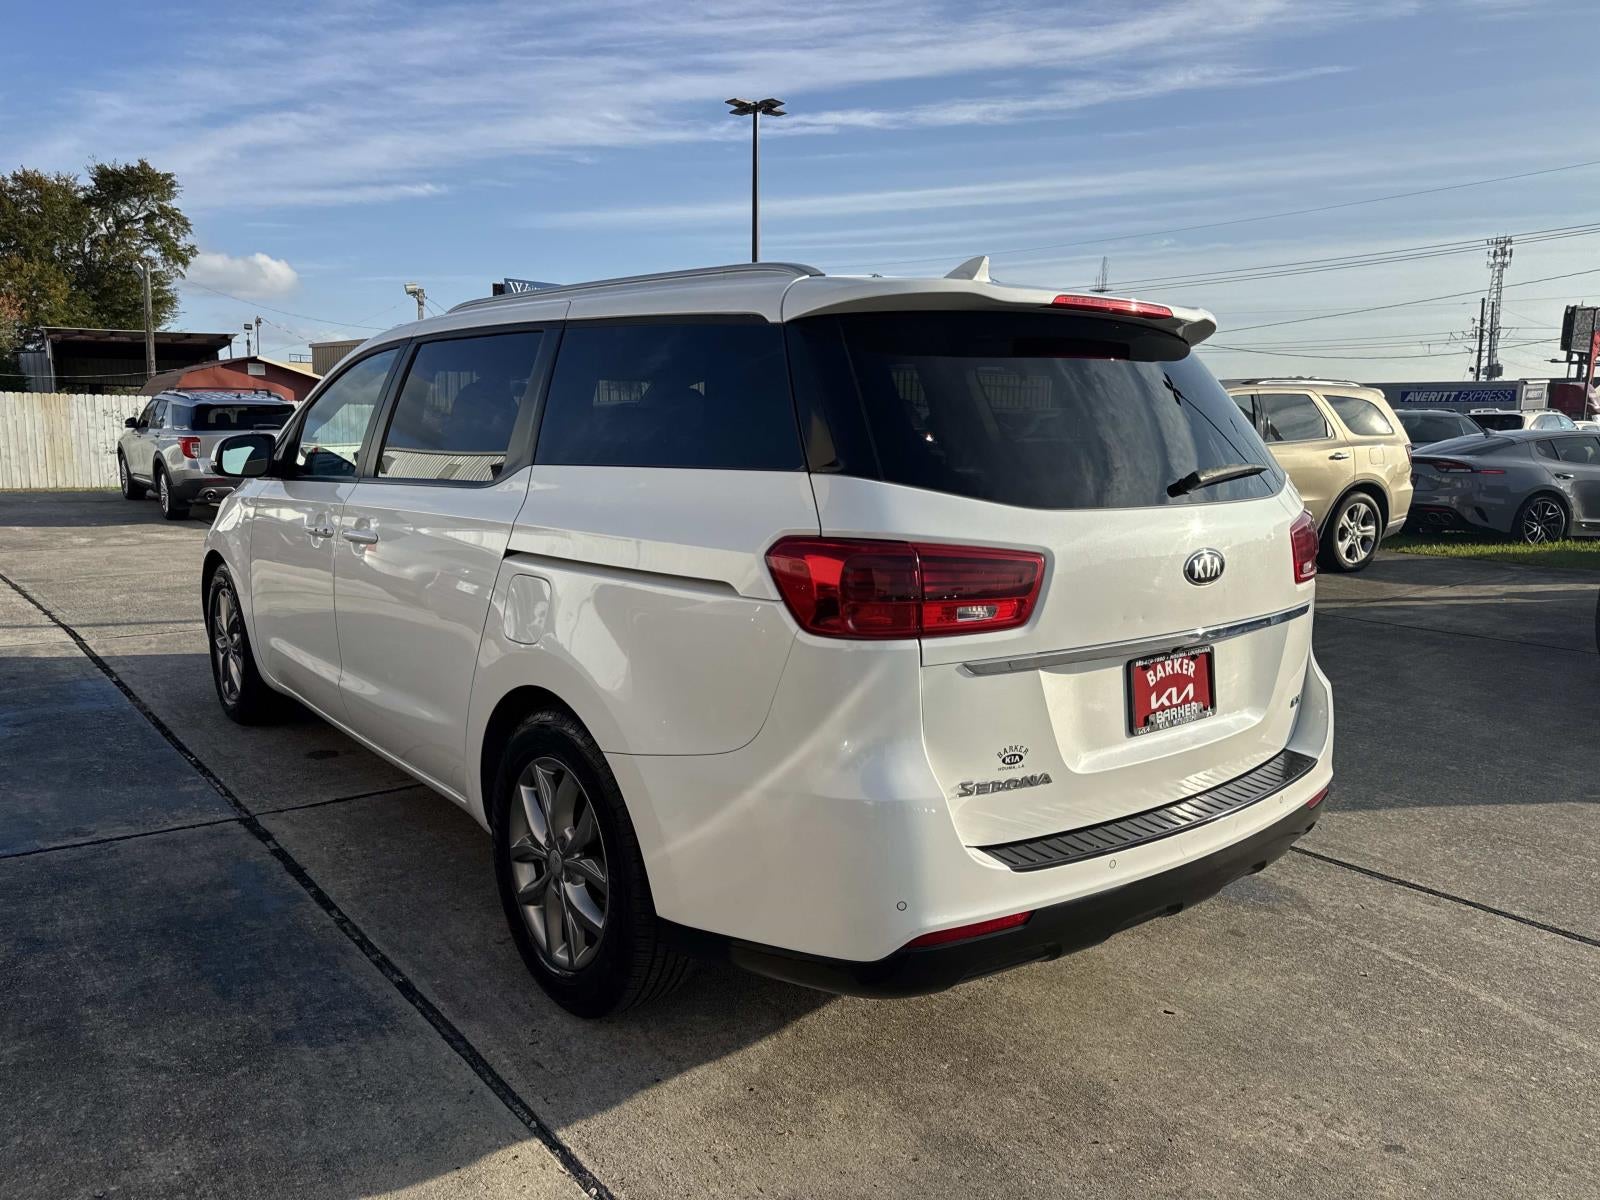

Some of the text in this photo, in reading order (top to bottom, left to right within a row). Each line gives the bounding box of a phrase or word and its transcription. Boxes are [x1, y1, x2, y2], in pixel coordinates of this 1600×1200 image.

[1404, 390, 1512, 402] AVERITT EXPRESS
[1193, 557, 1220, 579] KIA
[1146, 658, 1196, 688] BARKER
[1150, 682, 1194, 710] KIA
[996, 744, 1029, 759] BARKER
[1004, 755, 1020, 764] KIA
[956, 772, 1053, 798] SEDONA
